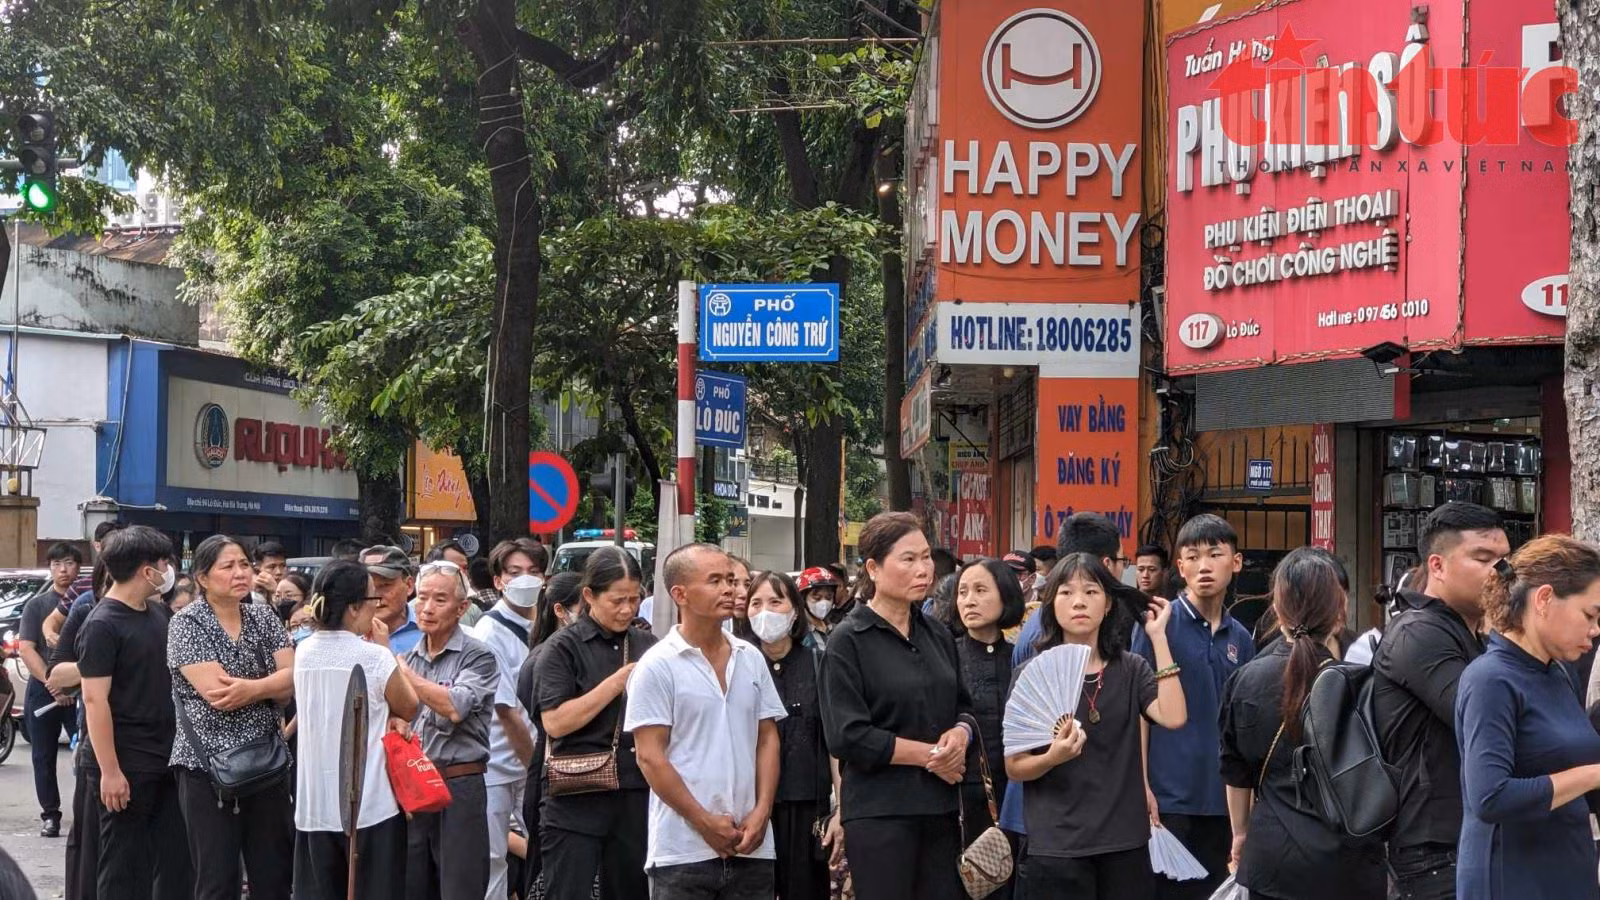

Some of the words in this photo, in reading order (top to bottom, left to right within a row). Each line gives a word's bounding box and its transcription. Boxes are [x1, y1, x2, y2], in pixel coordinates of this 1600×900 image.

[1185, 37, 1223, 77] Tuấn
[944, 139, 1137, 197] HAPPY
[941, 209, 1141, 267] MONEY
[1204, 219, 1239, 252] PHỤ
[1243, 206, 1281, 247] KIỆN
[1287, 197, 1329, 238] ĐIỆN
[1334, 188, 1394, 227] THOẠI
[1204, 254, 1229, 291] ĐỒ
[1232, 253, 1276, 287] CHƠI
[1280, 242, 1335, 280] CÔNG
[1340, 228, 1396, 272] NGHỆ
[754, 292, 797, 312] PHỐ
[712, 313, 761, 347] NGUYỄN
[766, 316, 799, 347] CÔNG
[803, 315, 829, 347] TRỨ
[1187, 320, 1211, 342] 117
[1226, 320, 1238, 339] Lò
[1239, 318, 1261, 338] Đúc
[713, 382, 731, 400] PHỐ
[696, 400, 711, 432] LÒ
[715, 405, 741, 435] ĐÚC
[1058, 404, 1083, 433] VAY
[1088, 394, 1126, 433] BẰNG
[1057, 450, 1095, 486] ĐĂNG
[1101, 451, 1121, 488] KÝ
[1263, 466, 1272, 479] 117
[1044, 504, 1055, 539] Ô
